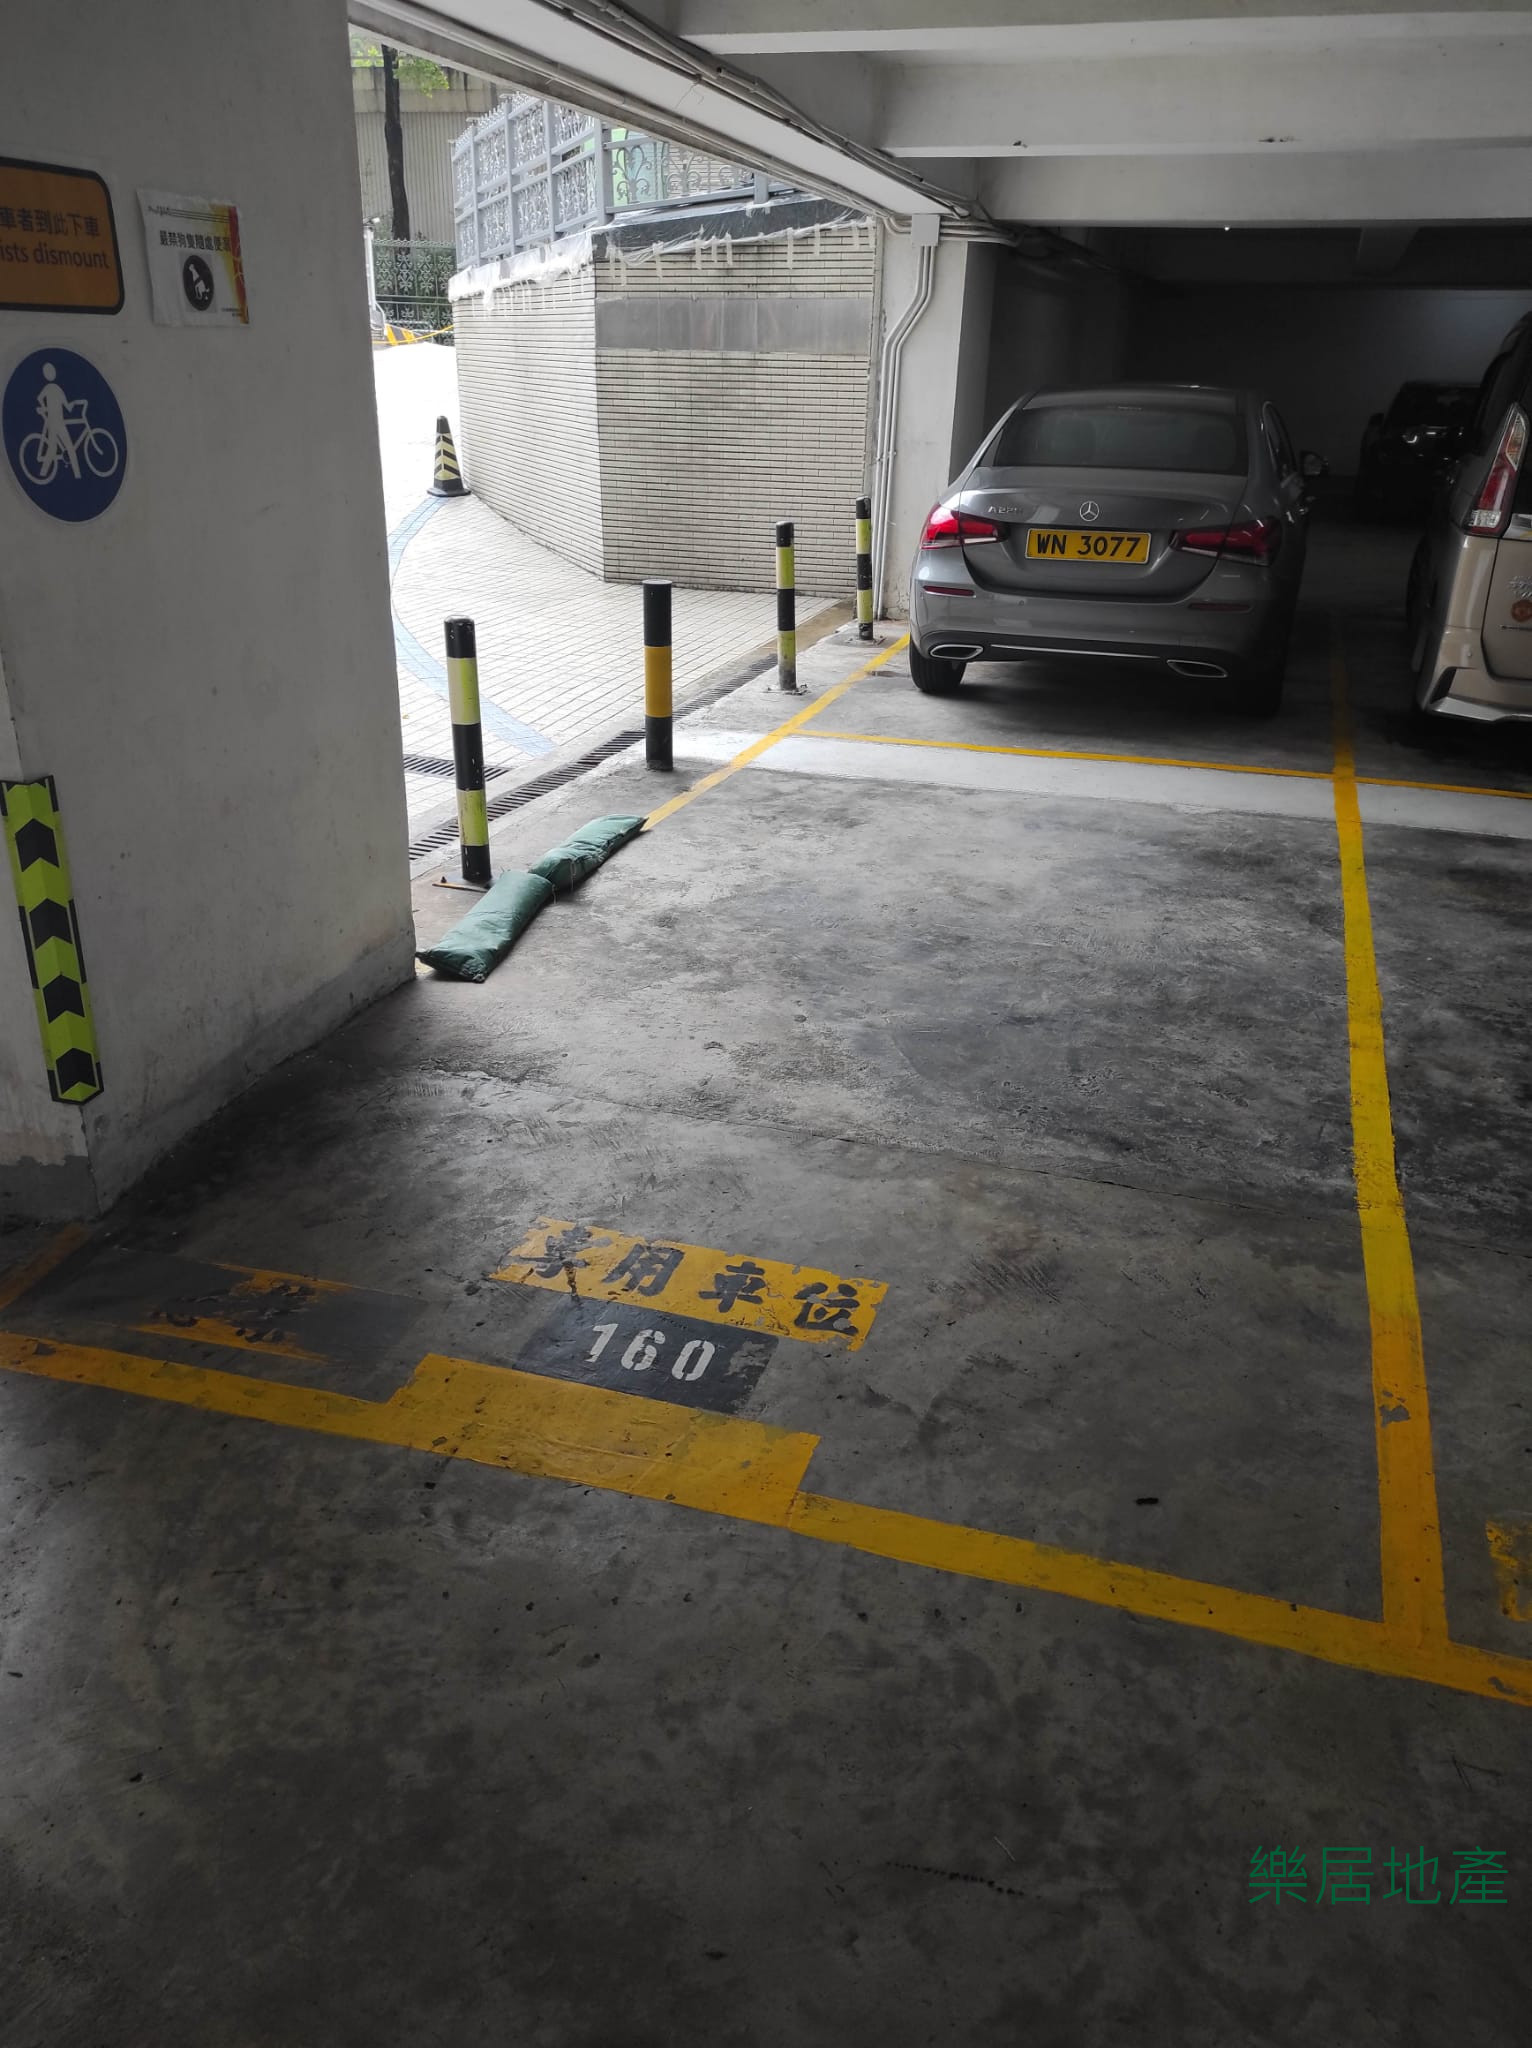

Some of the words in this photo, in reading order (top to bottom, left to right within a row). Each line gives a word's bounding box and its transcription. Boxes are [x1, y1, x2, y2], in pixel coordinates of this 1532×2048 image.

[33, 241, 110, 269] dismount
[1036, 533, 1067, 555] WN
[1077, 534, 1142, 558] 3077
[582, 1322, 716, 1381] 160
